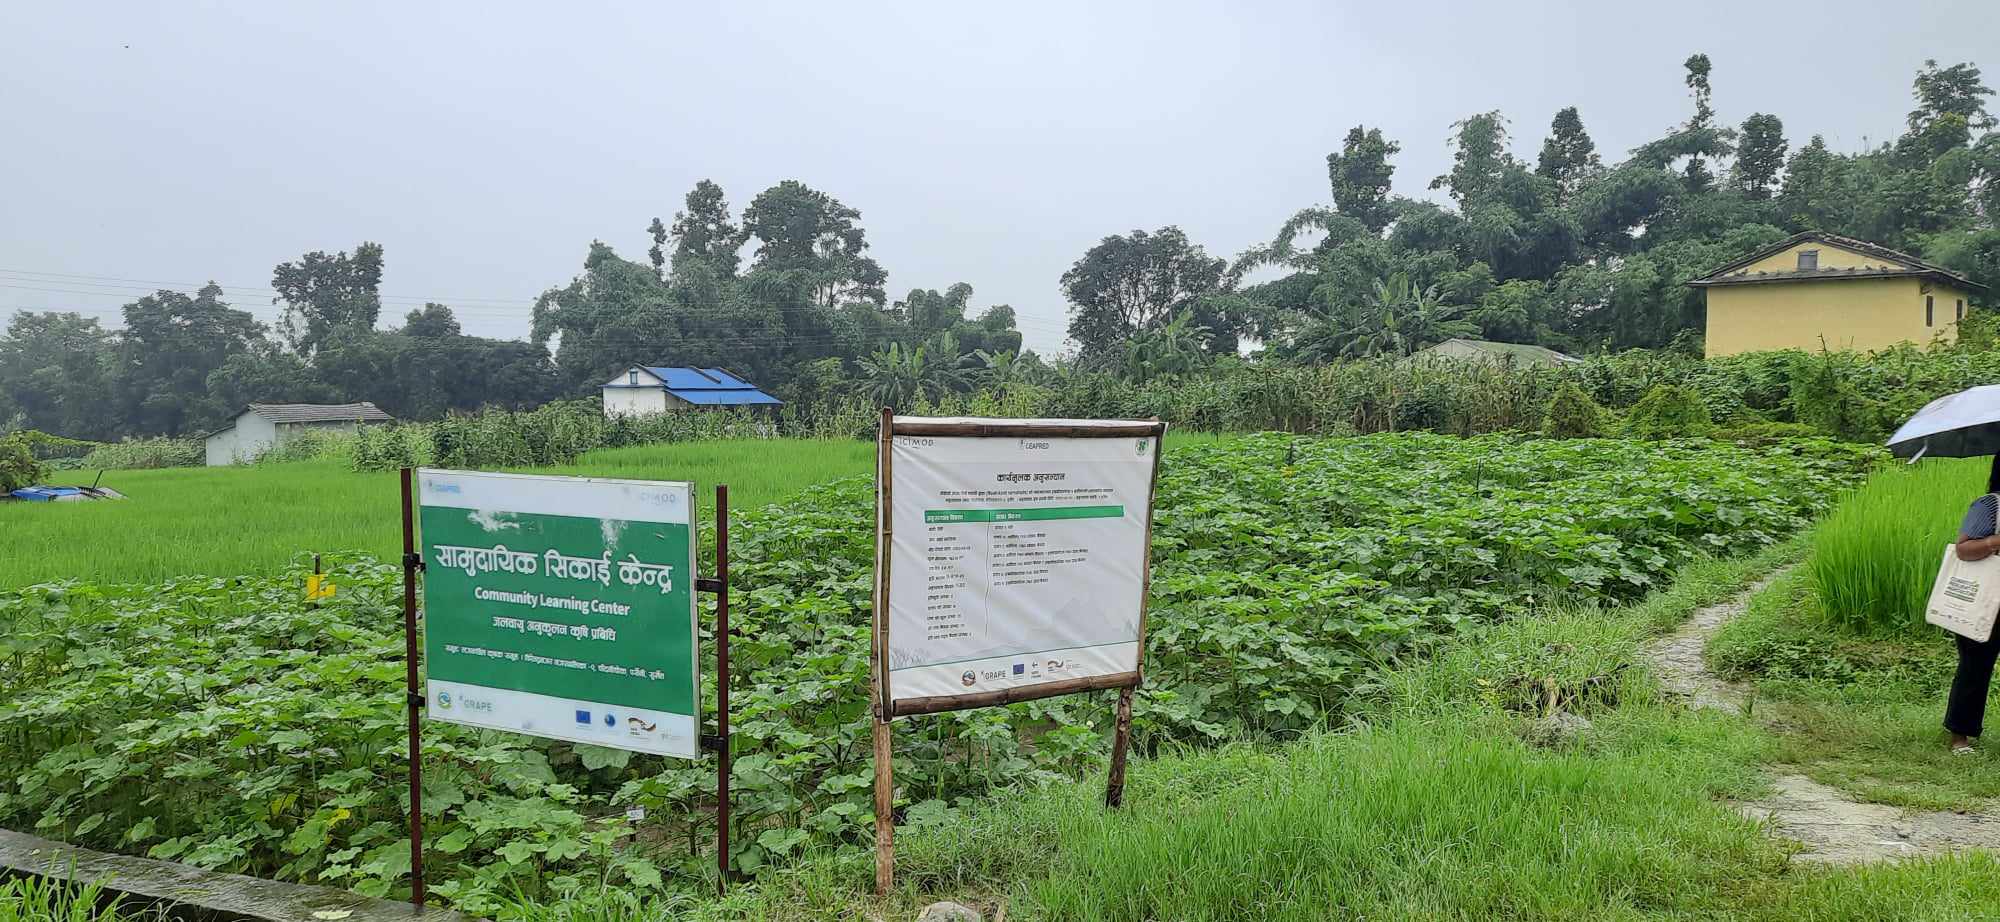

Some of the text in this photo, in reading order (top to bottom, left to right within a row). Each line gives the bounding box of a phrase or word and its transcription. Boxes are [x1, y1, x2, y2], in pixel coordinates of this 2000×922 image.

[434, 544, 673, 595] सामुदायिक सिकाई केन्द्र
[474, 586, 631, 616] Community Learning Center
[492, 616, 525, 634] जलवायु
[569, 624, 589, 641] कृषि
